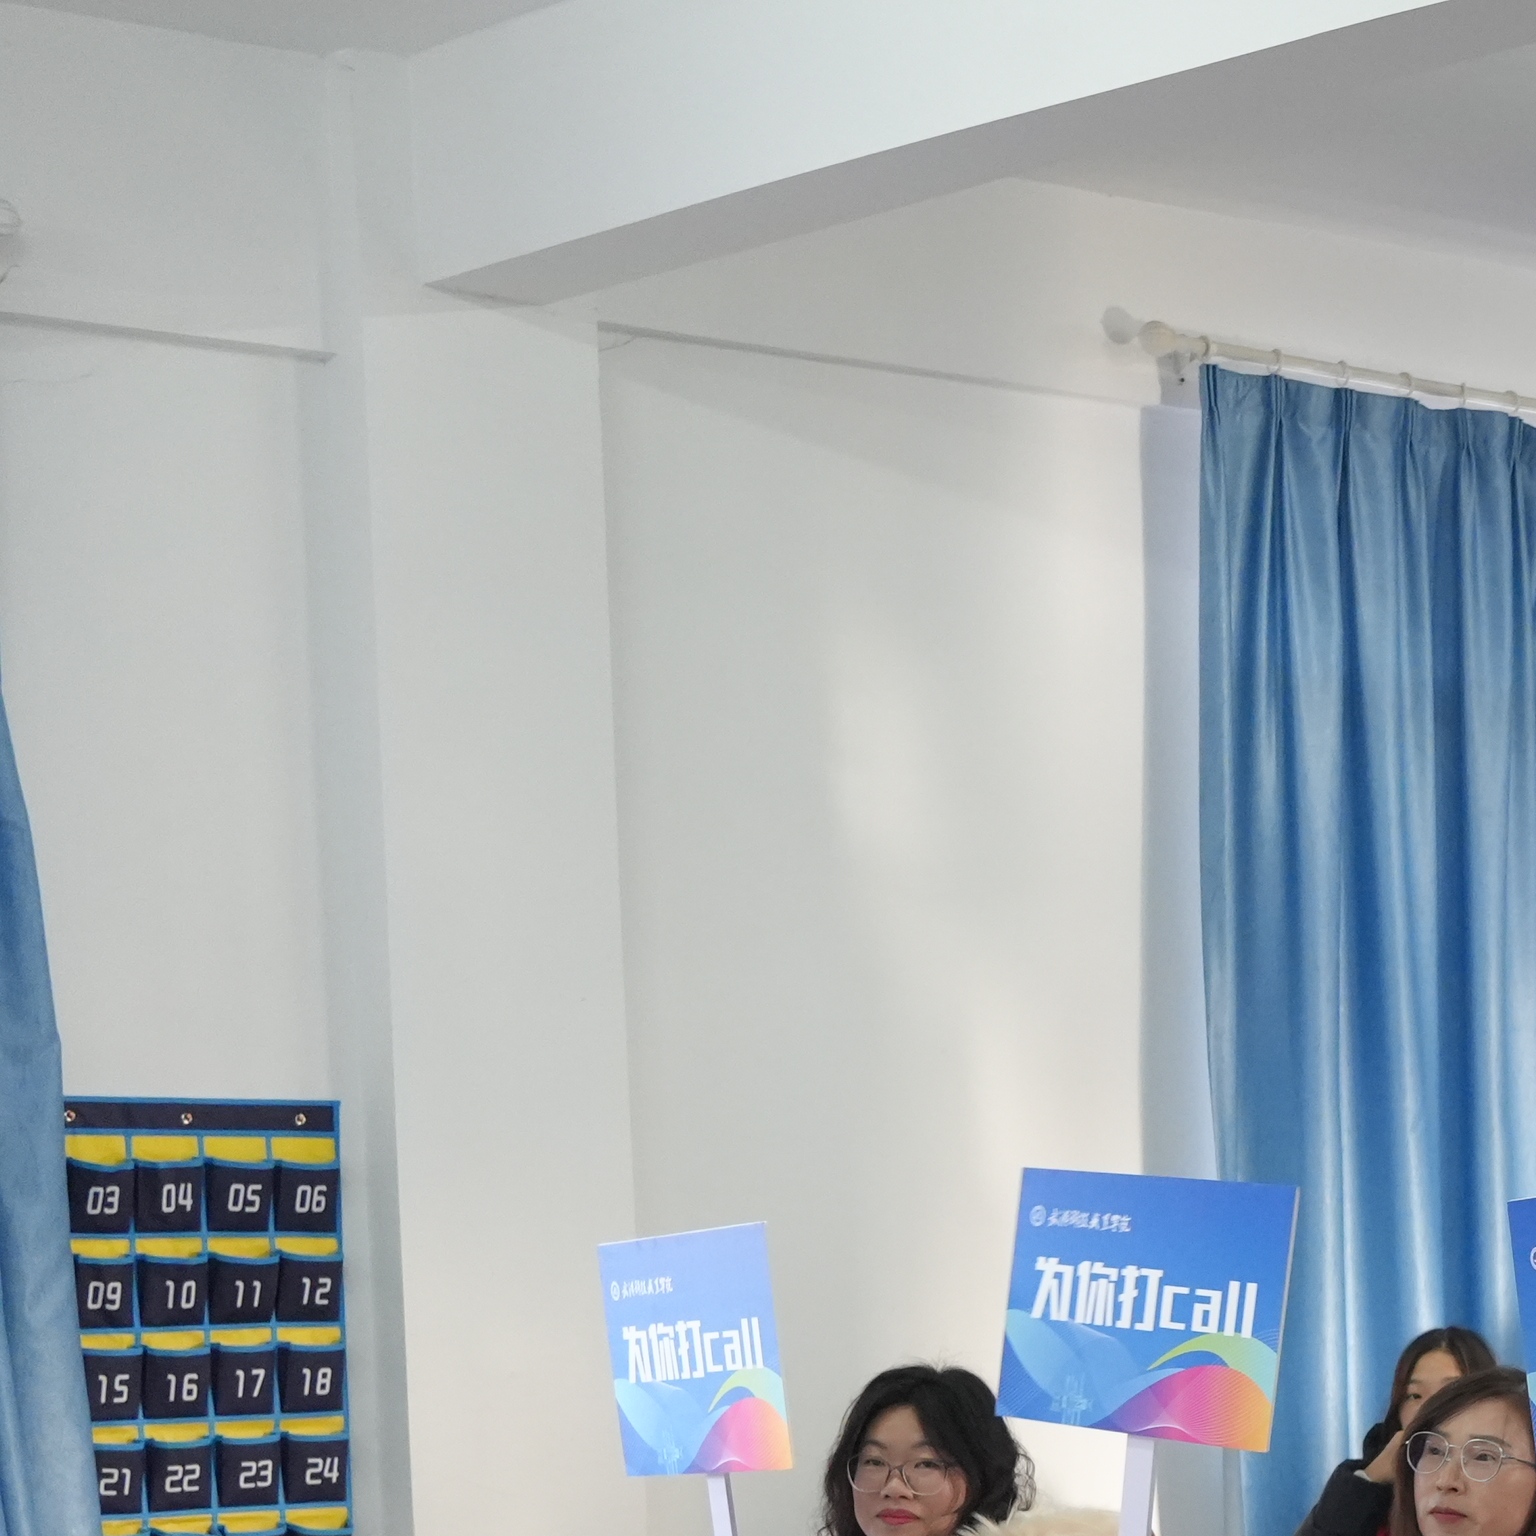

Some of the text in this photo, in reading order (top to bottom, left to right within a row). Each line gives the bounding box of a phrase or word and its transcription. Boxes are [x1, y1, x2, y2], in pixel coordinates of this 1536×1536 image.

[87, 1183, 327, 1214] 03 04 05 06
[88, 1277, 331, 1310] 09 10 11 12
[1029, 1256, 1258, 1339] 为你打call
[622, 1317, 764, 1384] 为你打call
[99, 1368, 331, 1403] 15 16 17 18
[100, 1457, 339, 1495] 21 22 23 24
